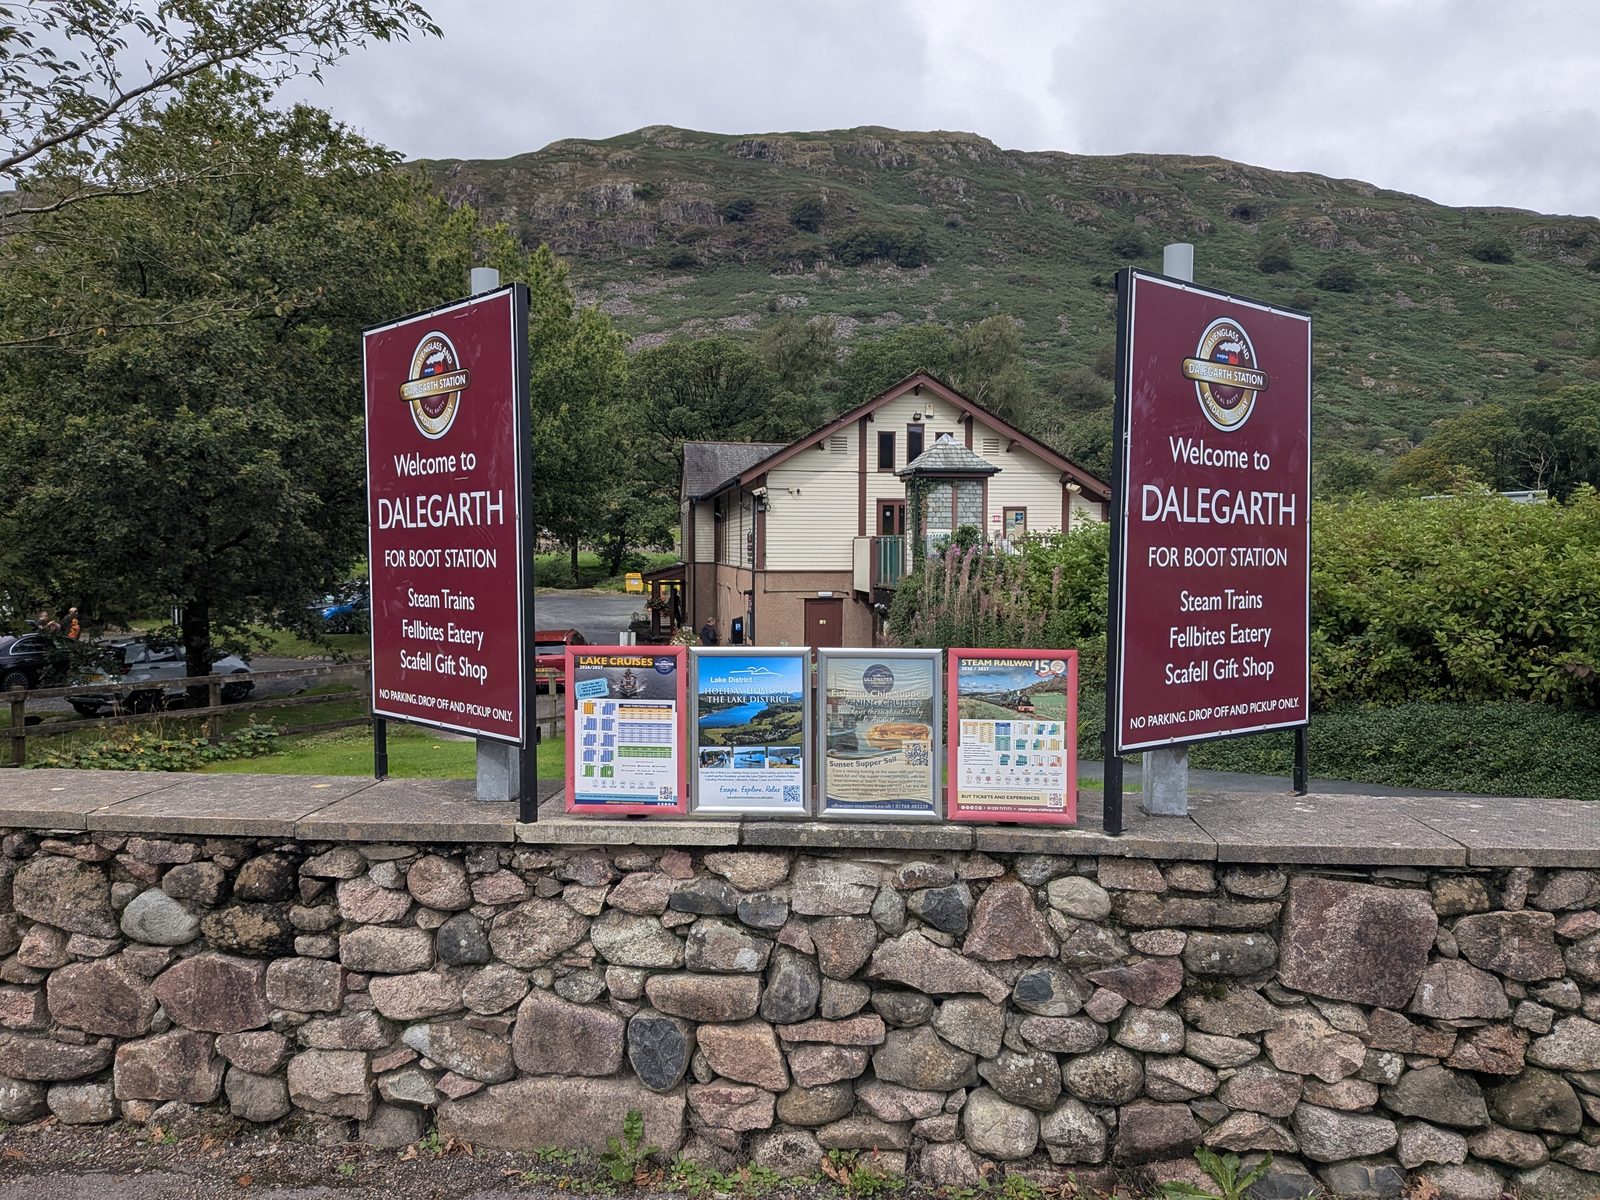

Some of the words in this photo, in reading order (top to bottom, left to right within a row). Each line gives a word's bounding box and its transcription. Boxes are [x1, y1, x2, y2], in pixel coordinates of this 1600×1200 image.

[443, 347, 453, 364] AND
[1238, 339, 1250, 360] AND
[404, 378, 438, 396] DALEGARTH
[439, 374, 466, 389] STATION
[1188, 363, 1232, 380] DALEGARTH
[1233, 371, 1263, 386] STATION
[394, 452, 456, 477] Welcome
[460, 451, 476, 471] to
[1169, 435, 1249, 469] Welcome
[1253, 450, 1270, 471] to
[378, 489, 504, 530] DALEGARTH
[1141, 484, 1296, 526] DALEGARTH
[385, 549, 407, 568] FOR
[409, 549, 441, 568] BOOT
[445, 549, 497, 568] STATION
[1148, 546, 1180, 568] FOR
[1184, 547, 1227, 567] BOOT
[1230, 547, 1288, 567] STATION
[408, 588, 440, 609] Steam
[441, 589, 475, 610] Trains
[1180, 590, 1222, 612] Steam
[1224, 589, 1263, 611] Trains
[402, 619, 444, 641] Fellbites
[448, 622, 484, 651] Eatery
[1169, 625, 1226, 649] Fellbites
[1230, 623, 1272, 648] Eatery
[400, 649, 432, 672] Scafell
[435, 653, 456, 675] Gift
[459, 656, 488, 685] Shop
[579, 656, 608, 665] LAKE
[609, 657, 653, 666] CRUISES
[994, 659, 1034, 667] RAILWAY
[1034, 659, 1066, 673] 150
[1165, 660, 1209, 685] Scafell
[1213, 658, 1239, 680] Gift
[1242, 656, 1275, 681] Shop
[704, 687, 745, 695] HOLIDAY
[706, 695, 725, 703] THE
[727, 695, 747, 703] LAKE
[749, 695, 791, 703] DISTRICT
[831, 689, 848, 697] Fish
[870, 689, 891, 698] Chip
[379, 688, 390, 699] NO
[418, 695, 436, 708] DROP
[437, 698, 450, 710] OFF
[450, 700, 465, 713] AND
[466, 703, 491, 717] PICKUP
[1130, 716, 1146, 730] NO
[1188, 707, 1213, 722] DROP
[1214, 705, 1230, 718] OFF
[1230, 703, 1249, 716] AND
[1250, 699, 1277, 714] PICKUP
[1278, 696, 1300, 709] ONLY.
[856, 760, 882, 768] Supper
